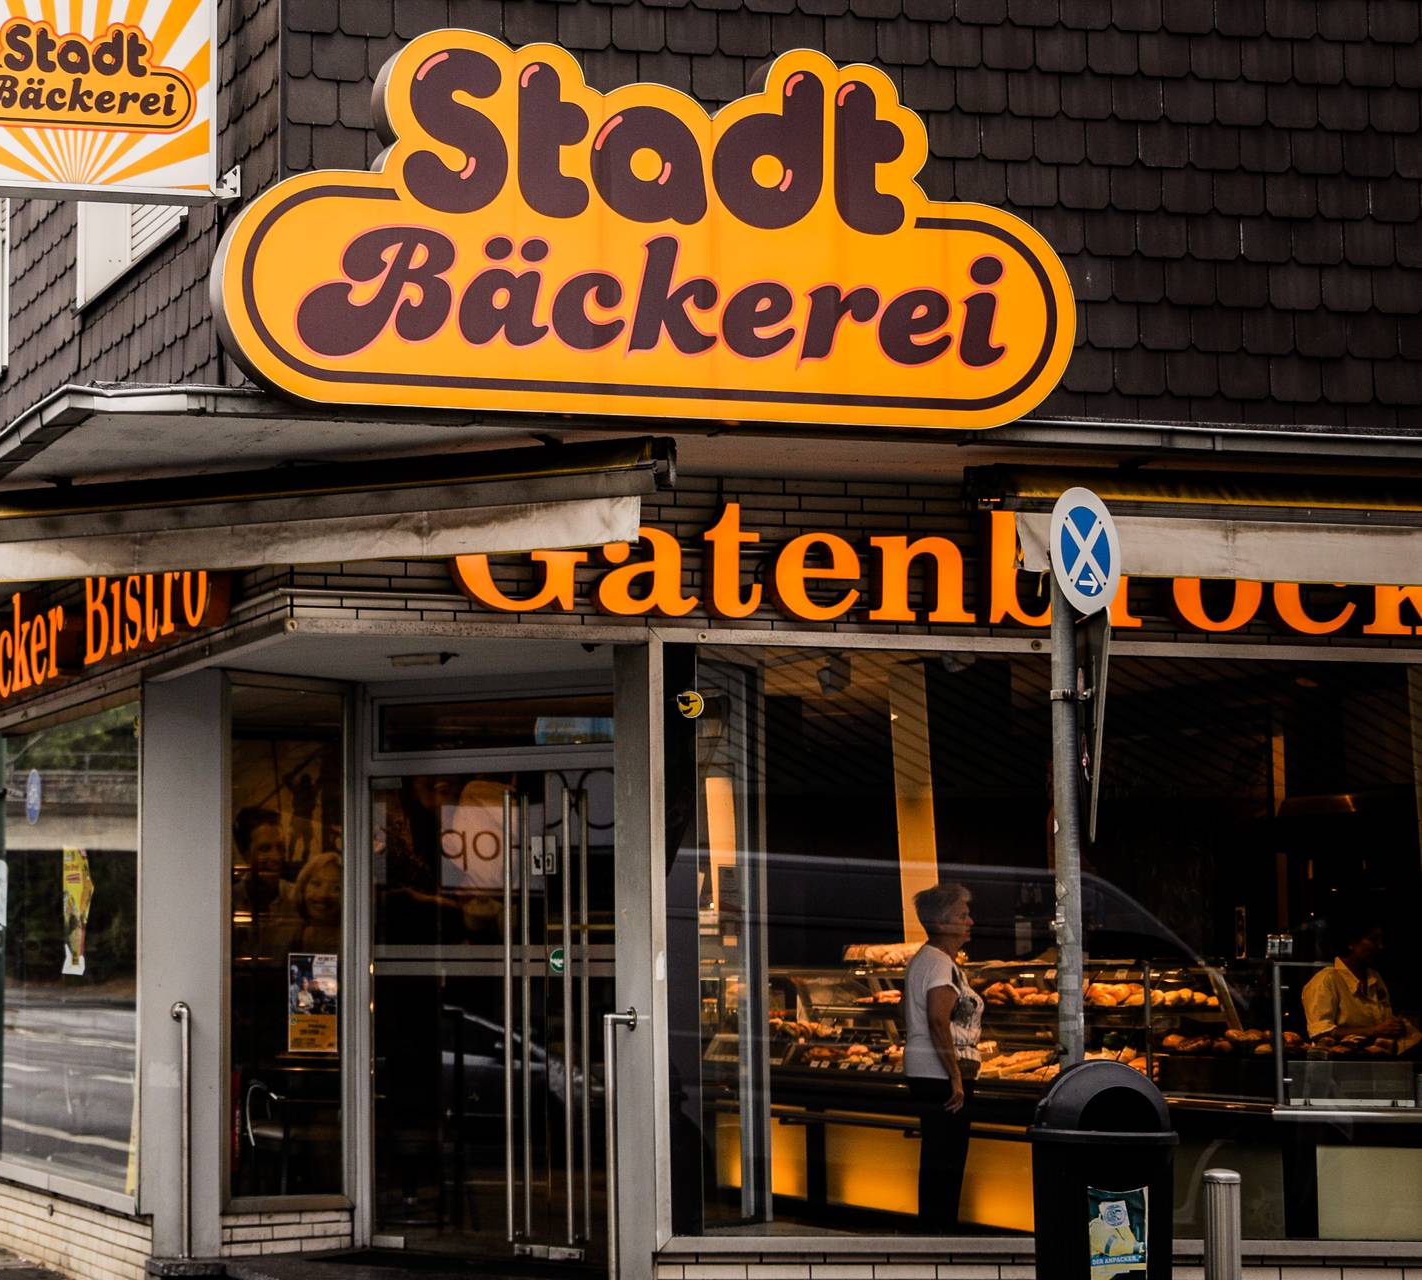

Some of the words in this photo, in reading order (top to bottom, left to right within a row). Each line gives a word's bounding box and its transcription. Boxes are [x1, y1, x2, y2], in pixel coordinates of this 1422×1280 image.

[4, 23, 148, 78] Stadt
[401, 47, 906, 236] Stadt
[295, 223, 1009, 370] Bäckerei
[84, 570, 207, 666] Bistro
[454, 502, 1422, 635] Gatenbc
